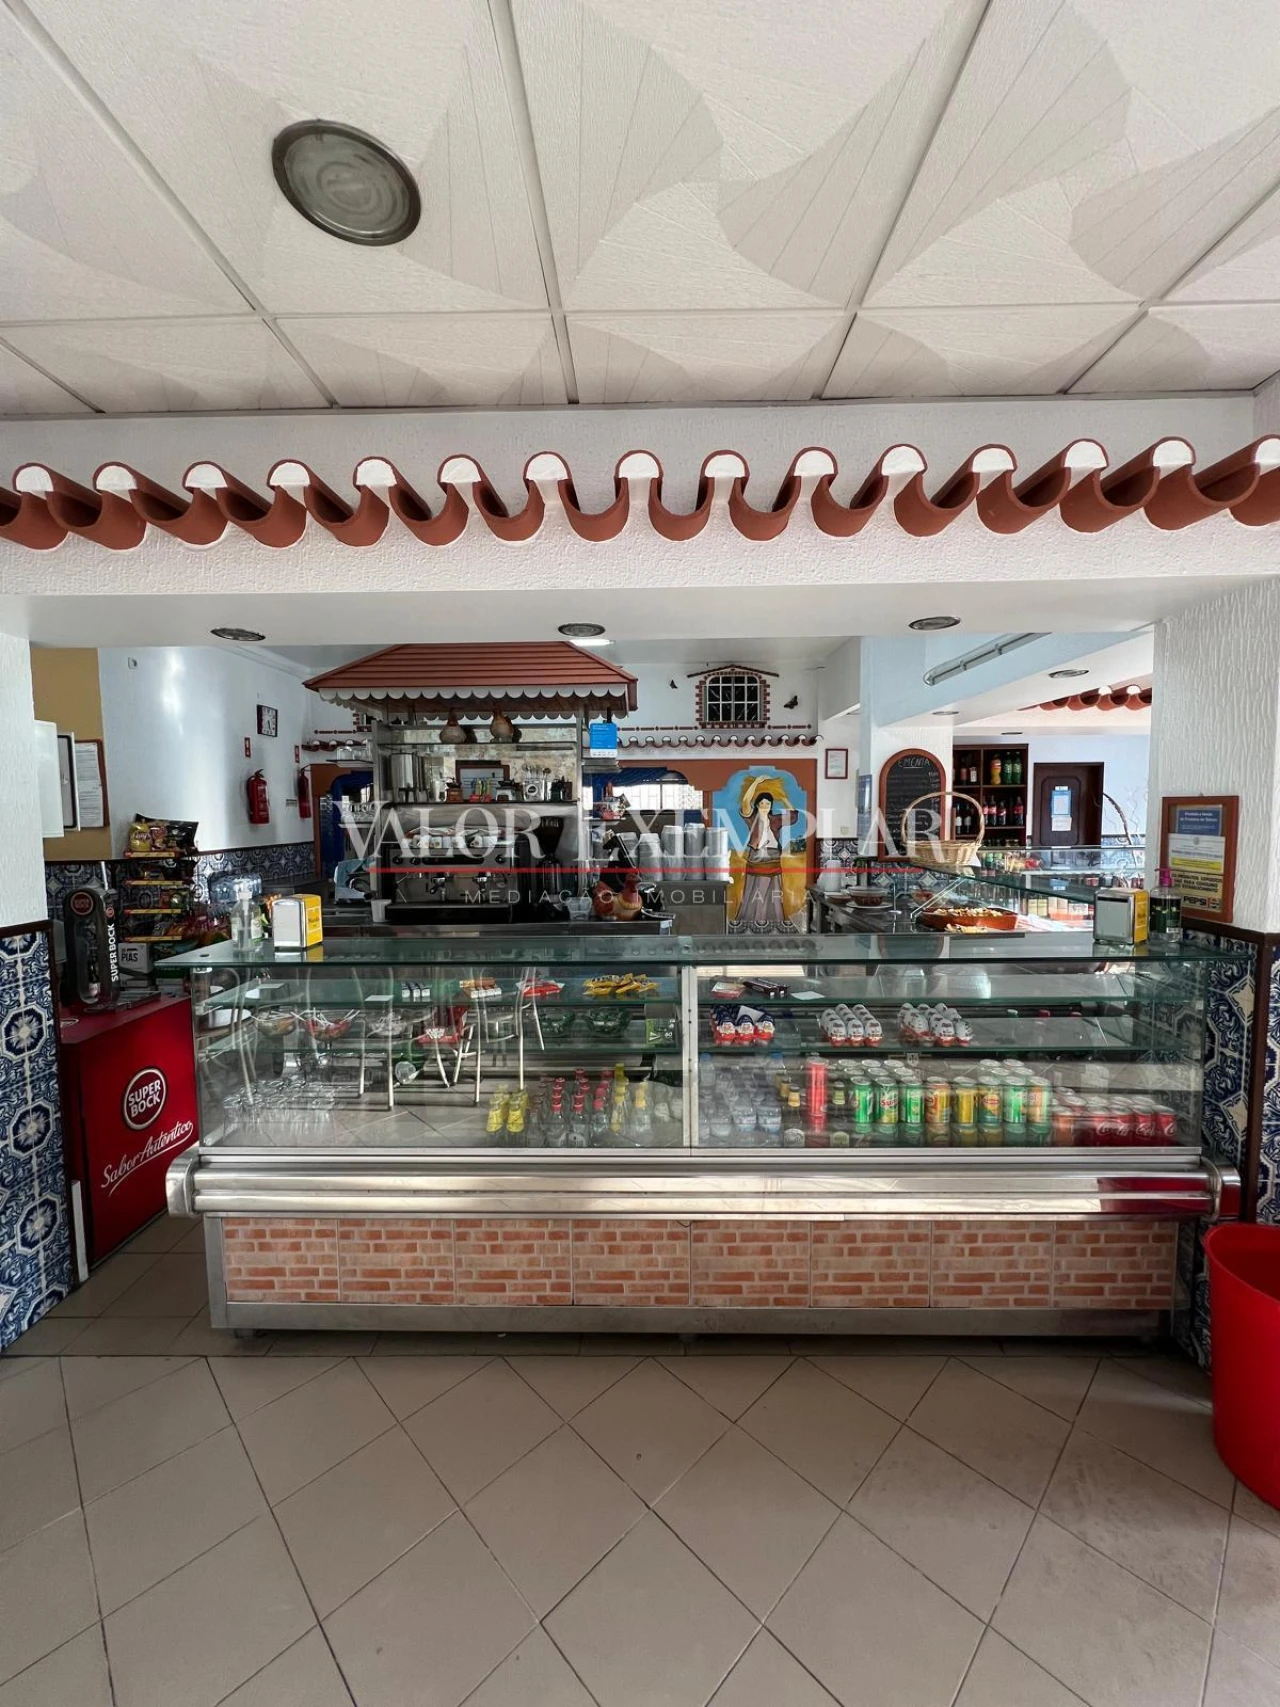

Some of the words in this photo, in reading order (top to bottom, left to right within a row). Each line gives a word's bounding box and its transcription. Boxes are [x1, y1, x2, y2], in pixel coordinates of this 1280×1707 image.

[107, 923, 117, 952] BOCK
[109, 952, 119, 982] SUPER
[128, 1079, 161, 1106] SUPER
[130, 1091, 160, 1118] BOCK
[100, 1154, 140, 1189] Sabor
